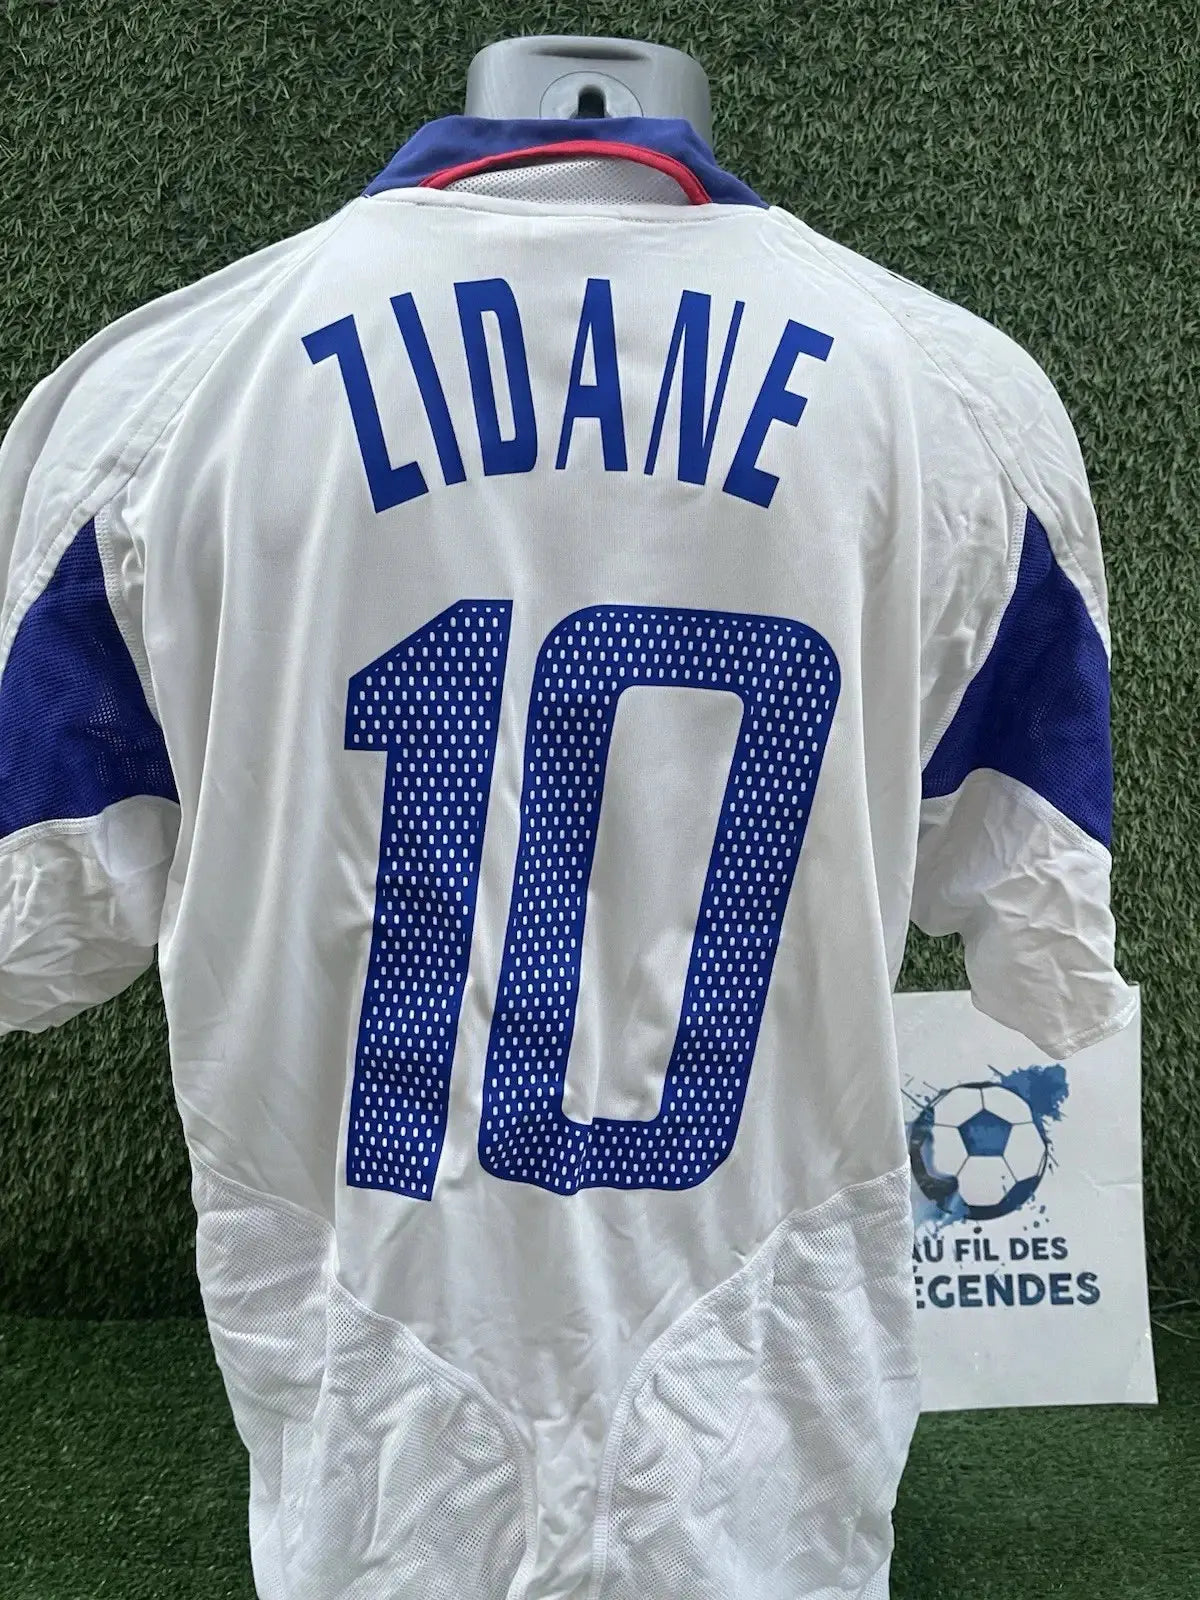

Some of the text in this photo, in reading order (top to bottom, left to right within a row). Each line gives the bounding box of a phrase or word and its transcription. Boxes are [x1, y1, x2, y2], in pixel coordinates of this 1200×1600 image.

[302, 278, 833, 511] ZIDANE
[346, 599, 841, 1200] 10
[954, 1238, 1000, 1262] FIL
[1009, 1236, 1068, 1261] DES
